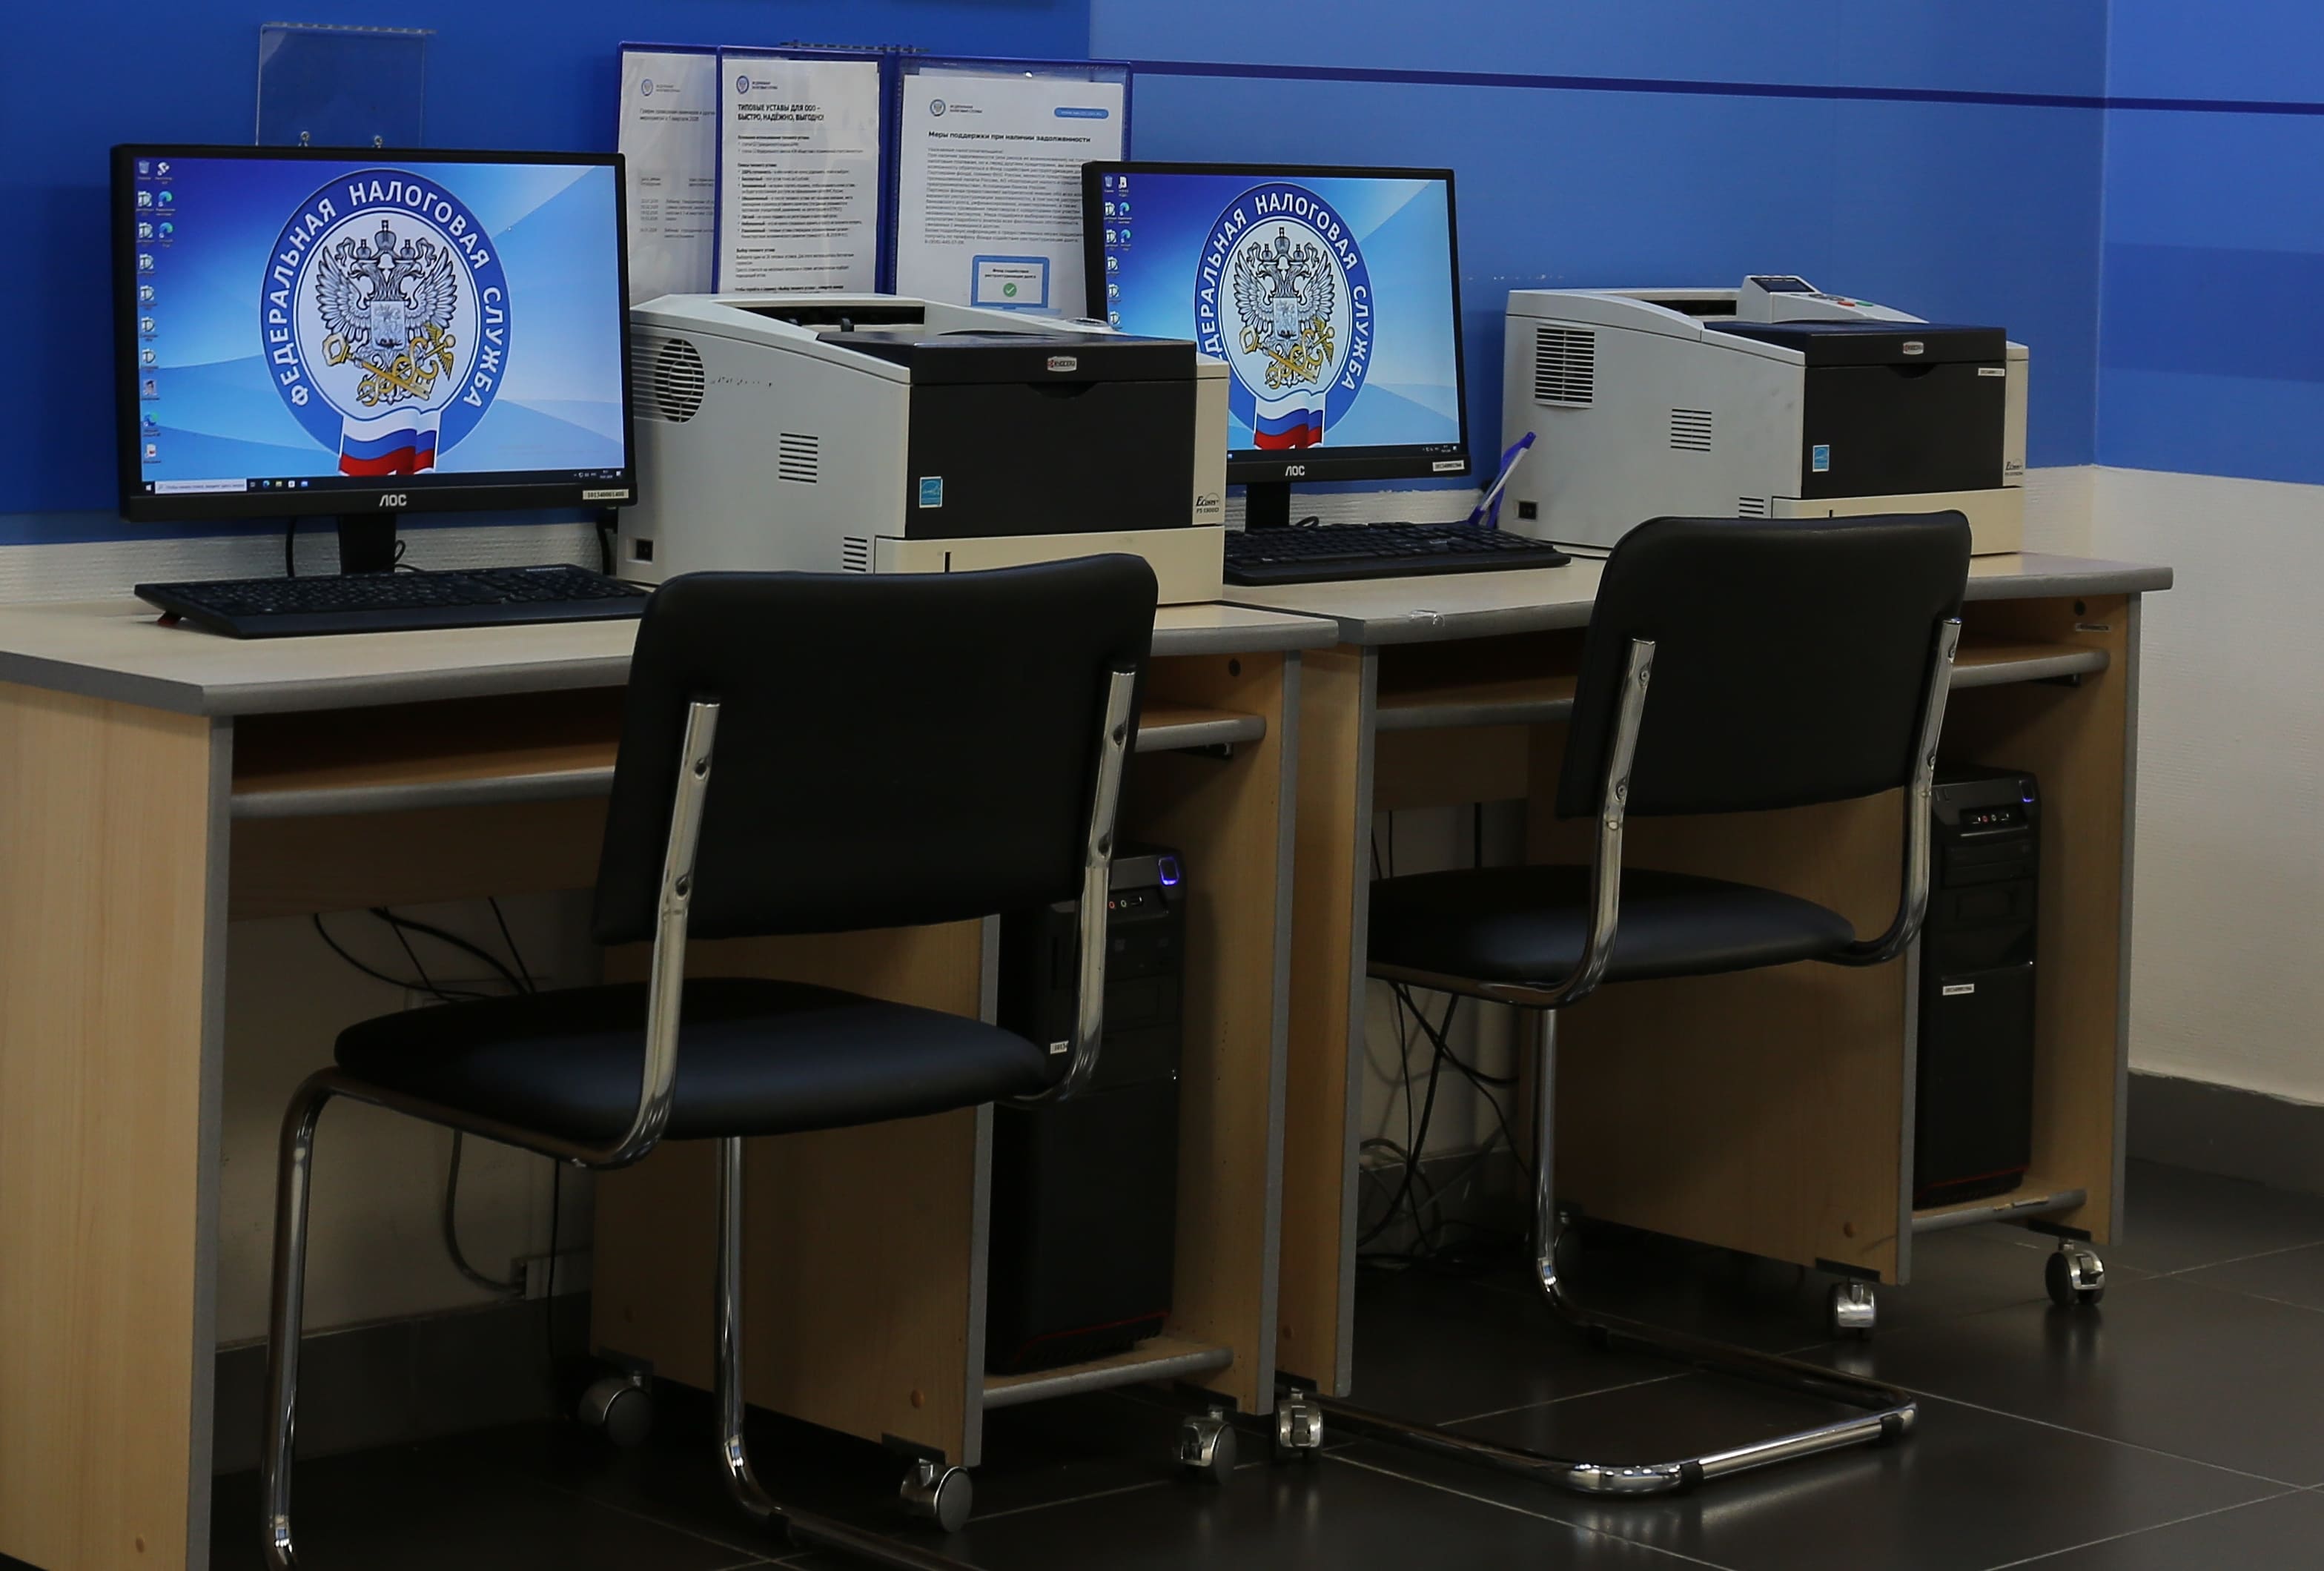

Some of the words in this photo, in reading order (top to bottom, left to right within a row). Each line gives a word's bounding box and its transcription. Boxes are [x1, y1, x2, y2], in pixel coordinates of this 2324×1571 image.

[928, 130, 949, 139] Меры
[268, 198, 337, 407] ФЕДЕРАЛЬНАЯ
[348, 180, 490, 271] НАЛОГОВАЯ
[463, 286, 504, 409] СЛУЖБА
[1199, 208, 1247, 360] ДЕРАЛЬНАЯ
[1254, 193, 1358, 271] НАЛОГОВАЯ
[1342, 285, 1369, 391] СЛУЖБА
[1285, 465, 1305, 477] AOC
[380, 494, 407, 507] AOC
